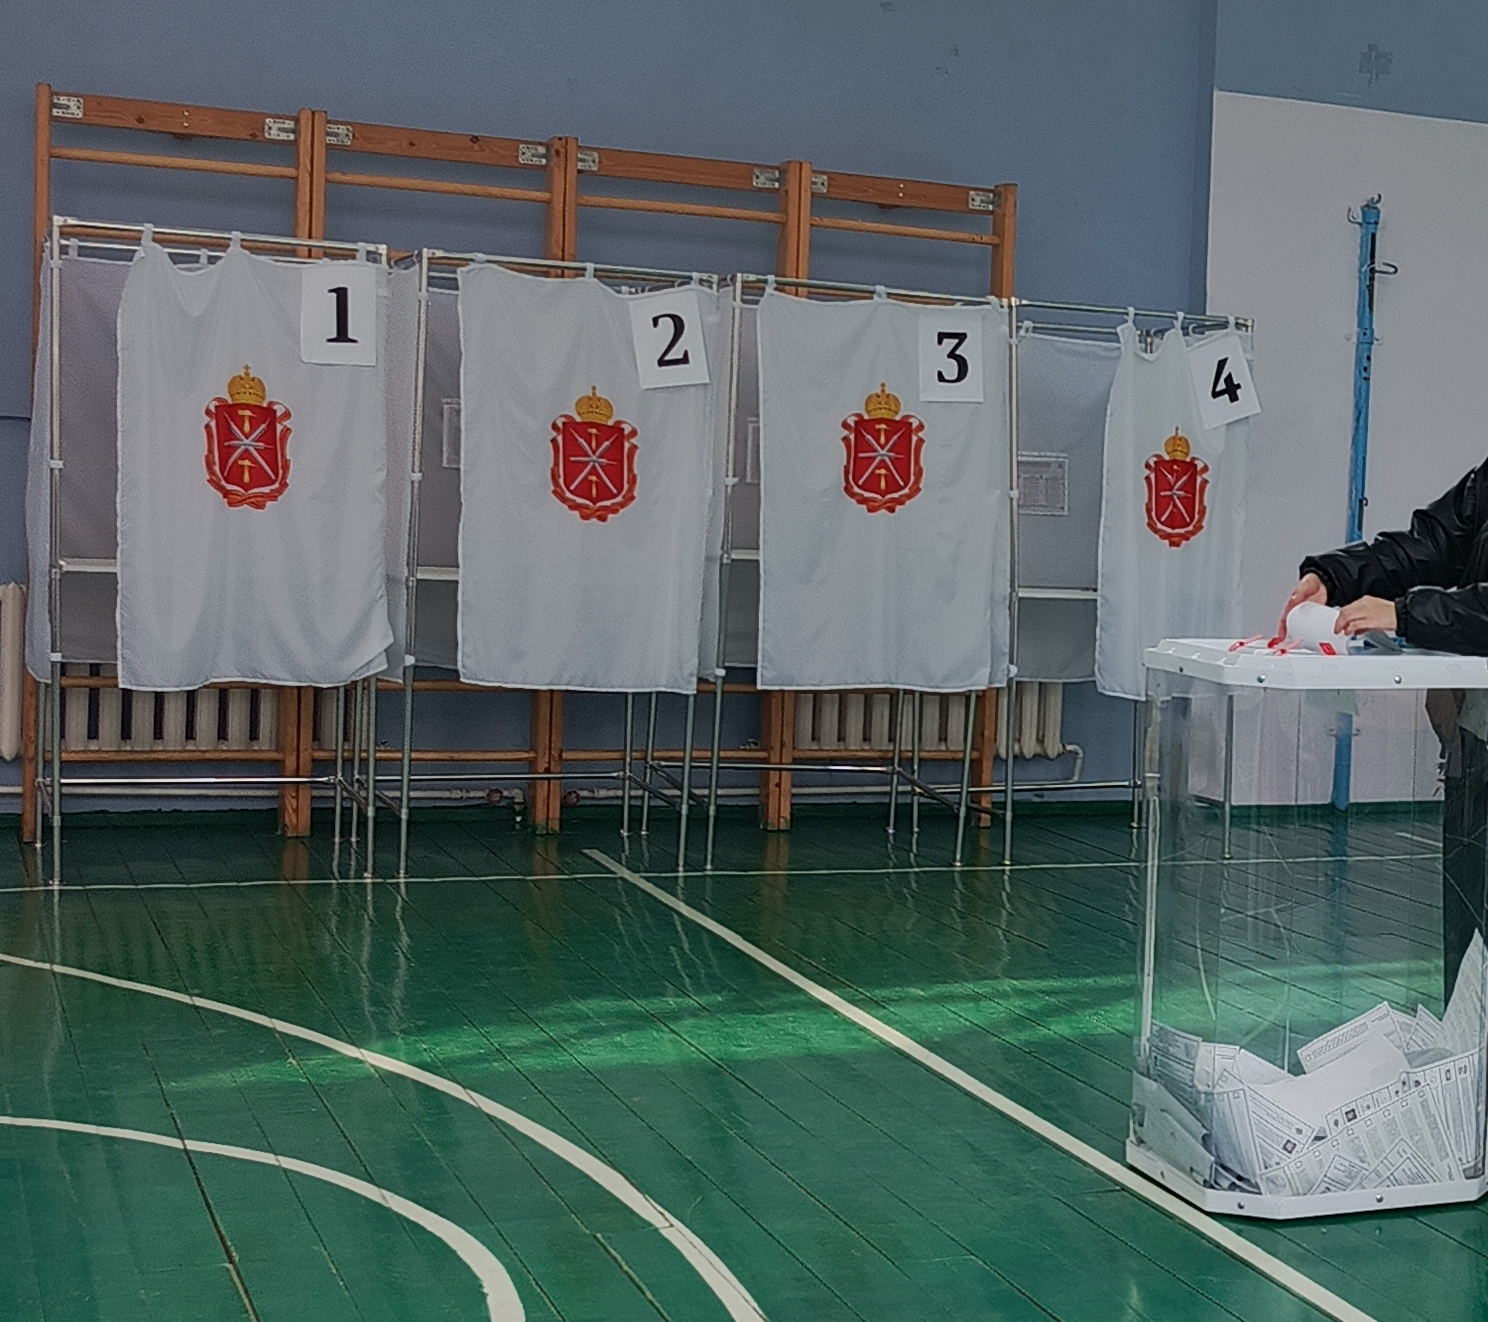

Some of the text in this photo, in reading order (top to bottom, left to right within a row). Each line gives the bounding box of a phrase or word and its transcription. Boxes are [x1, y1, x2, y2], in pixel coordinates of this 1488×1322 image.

[326, 286, 359, 344] 1
[651, 313, 691, 368] 2
[937, 331, 969, 384] 3
[1211, 356, 1242, 404] 4
